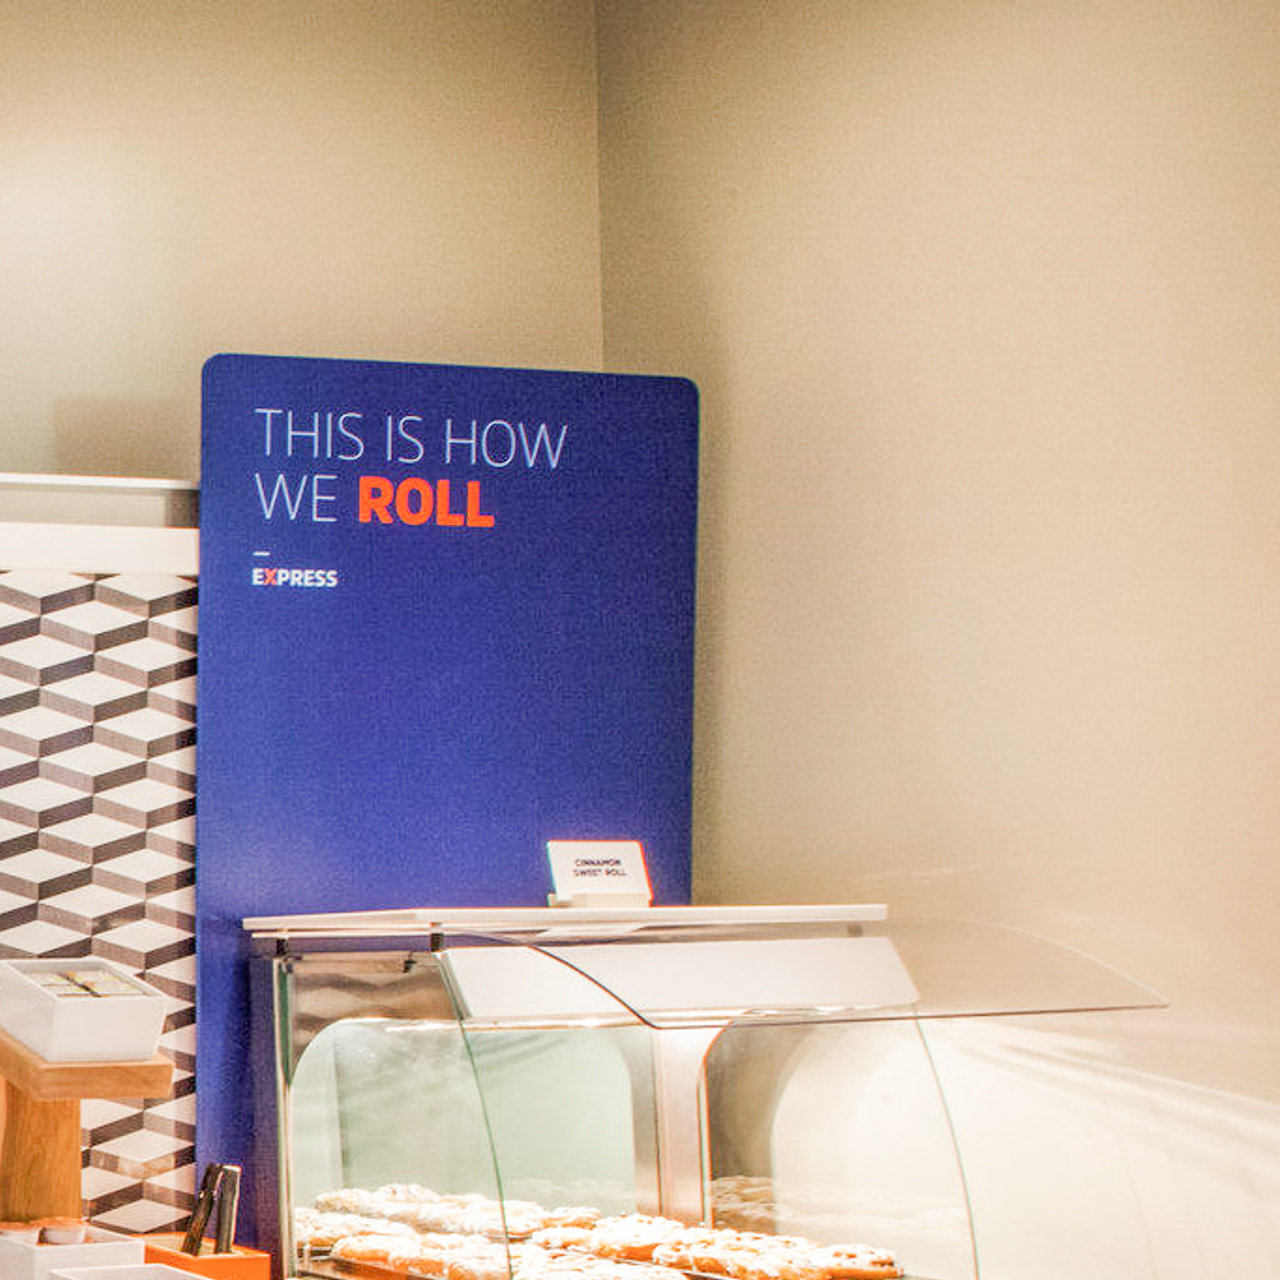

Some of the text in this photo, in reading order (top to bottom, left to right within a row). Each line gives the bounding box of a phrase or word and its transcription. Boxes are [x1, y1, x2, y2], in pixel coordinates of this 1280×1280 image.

[254, 408, 568, 469] THIS IS HOW
[254, 472, 495, 528] WE ROLL
[251, 567, 338, 587] EXPRESS
